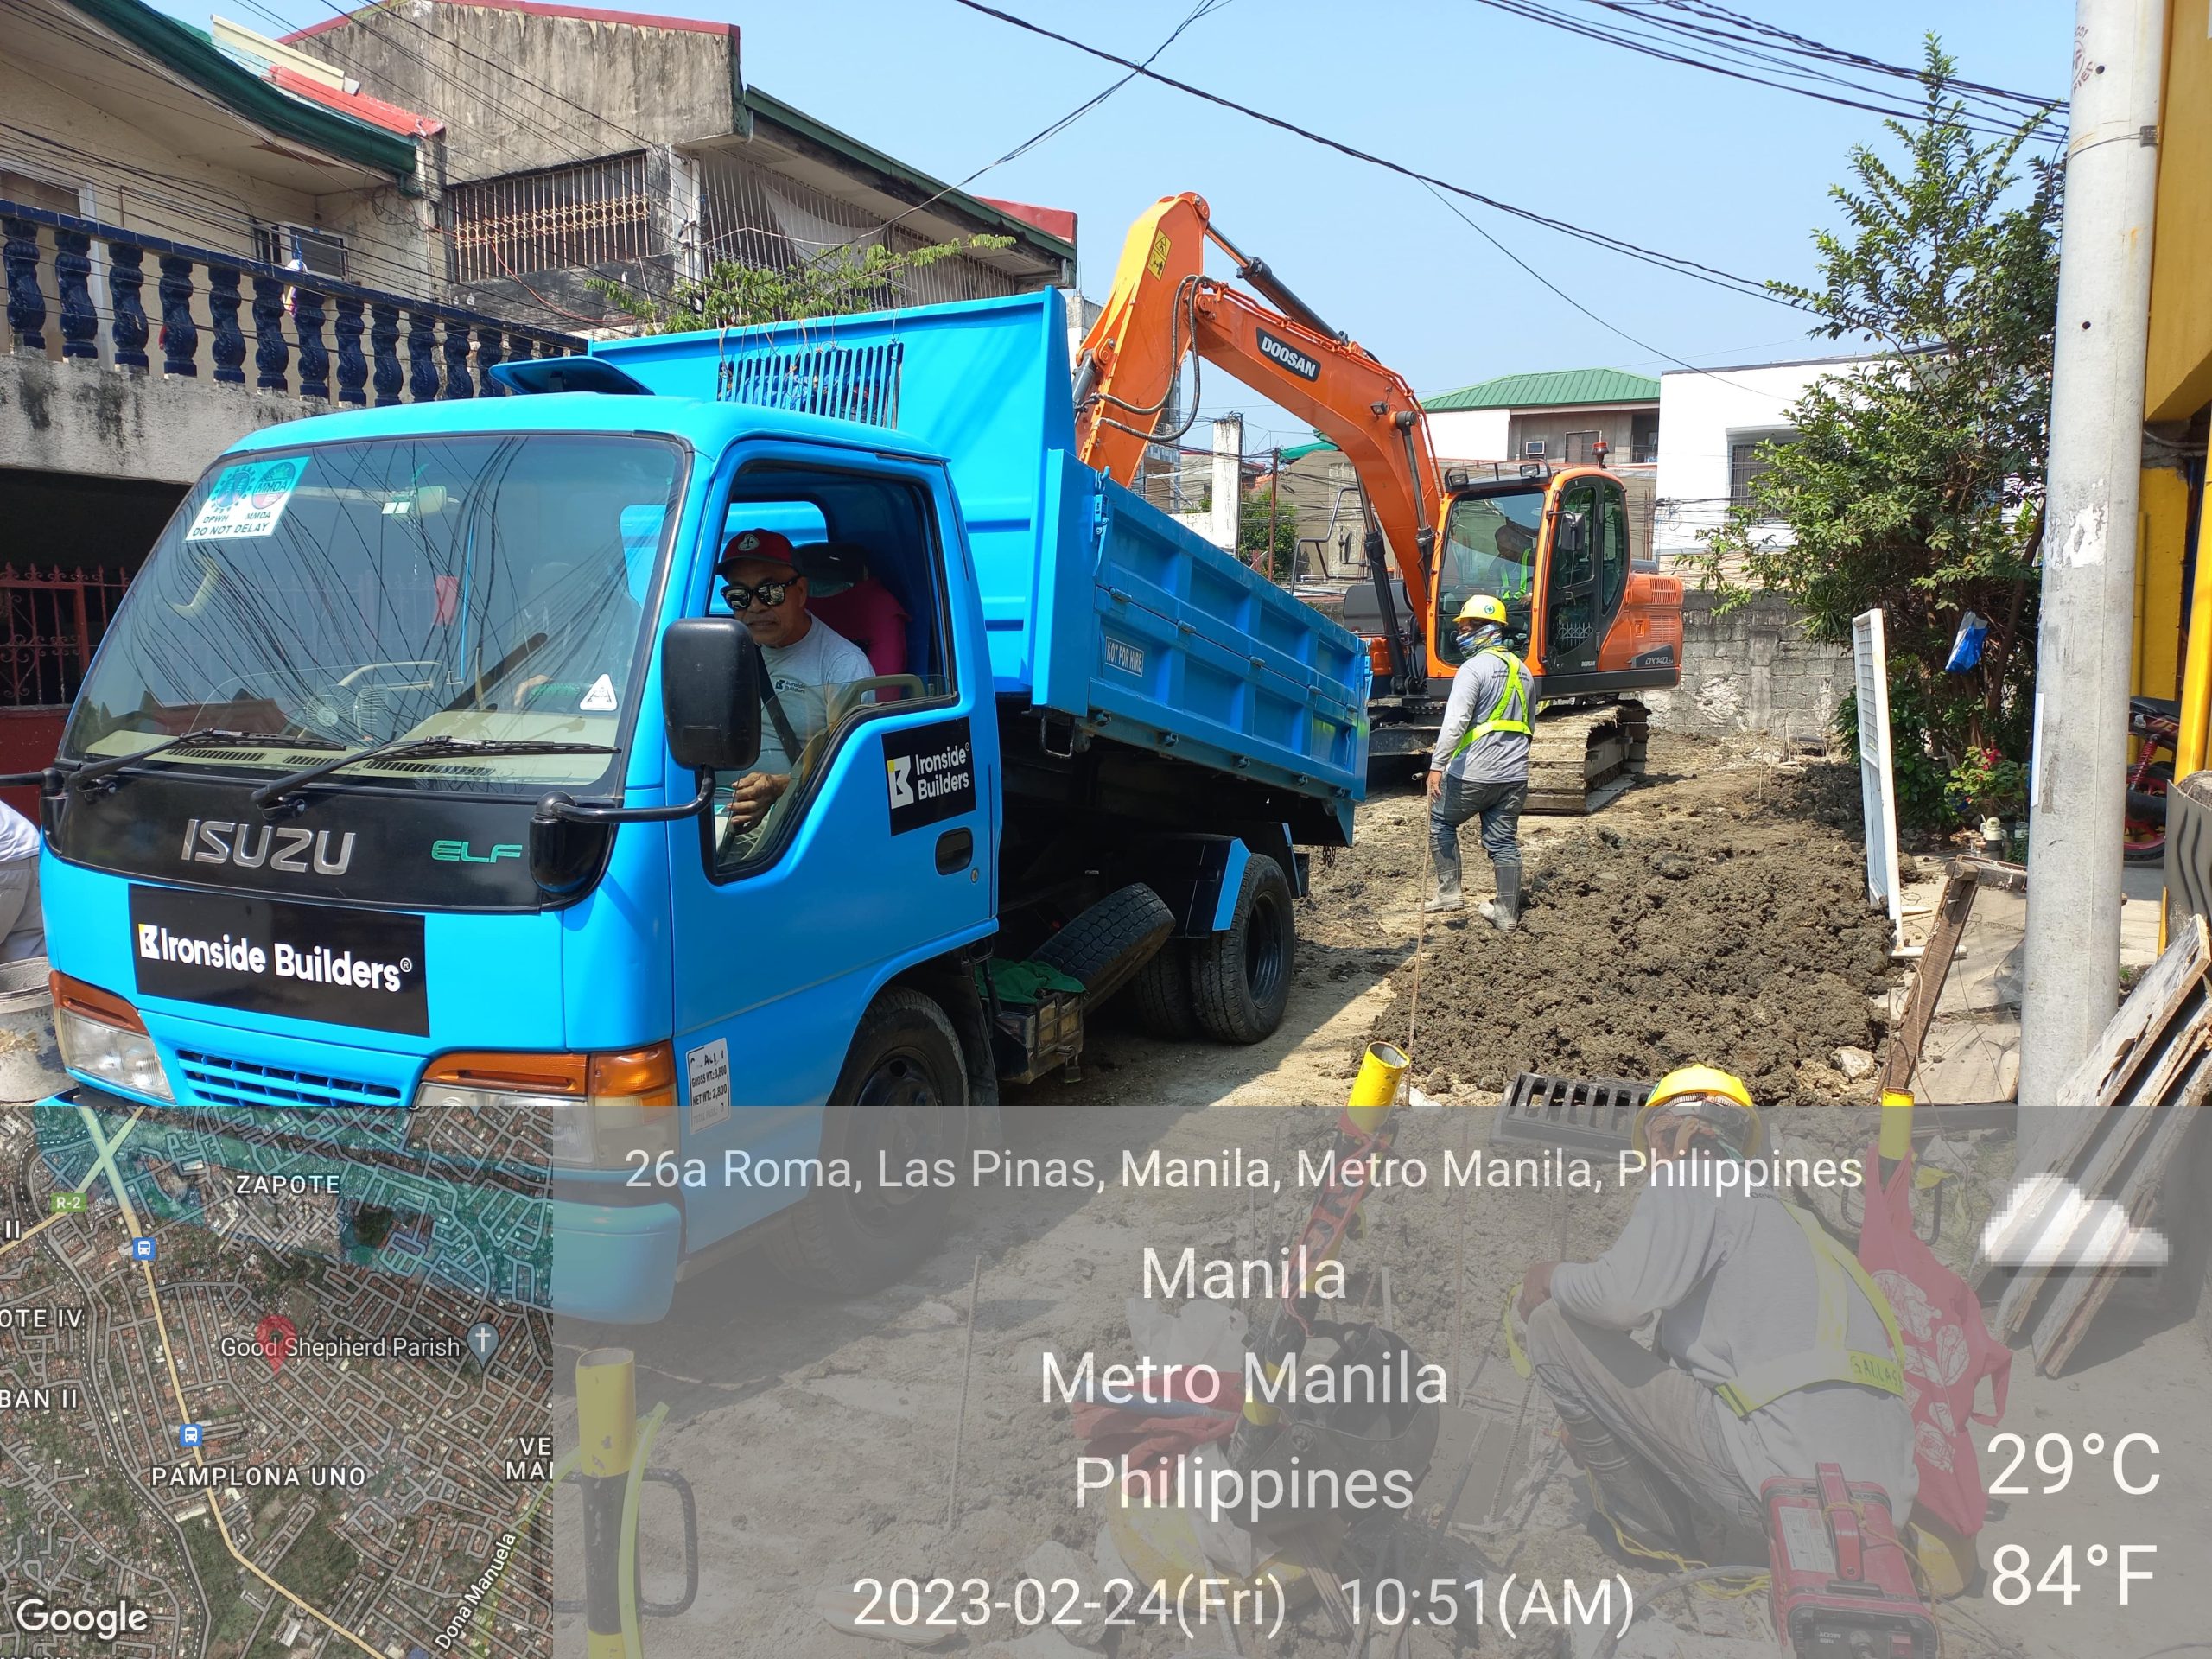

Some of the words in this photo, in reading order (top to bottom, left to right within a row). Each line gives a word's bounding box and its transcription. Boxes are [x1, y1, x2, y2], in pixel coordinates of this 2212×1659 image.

[1262, 336, 1316, 377] DOOSAN
[256, 480, 289, 493] MMDA
[192, 527, 207, 536] DO
[210, 525, 233, 534] NOT
[233, 522, 270, 533] DELAY
[918, 772, 969, 800] Builders
[181, 818, 356, 875] ISUZU
[431, 840, 523, 863] ELF
[160, 927, 266, 974] Ironside
[691, 1076, 706, 1088] GROSS
[692, 1093, 702, 1106] NET
[712, 1084, 727, 1099] 2,800
